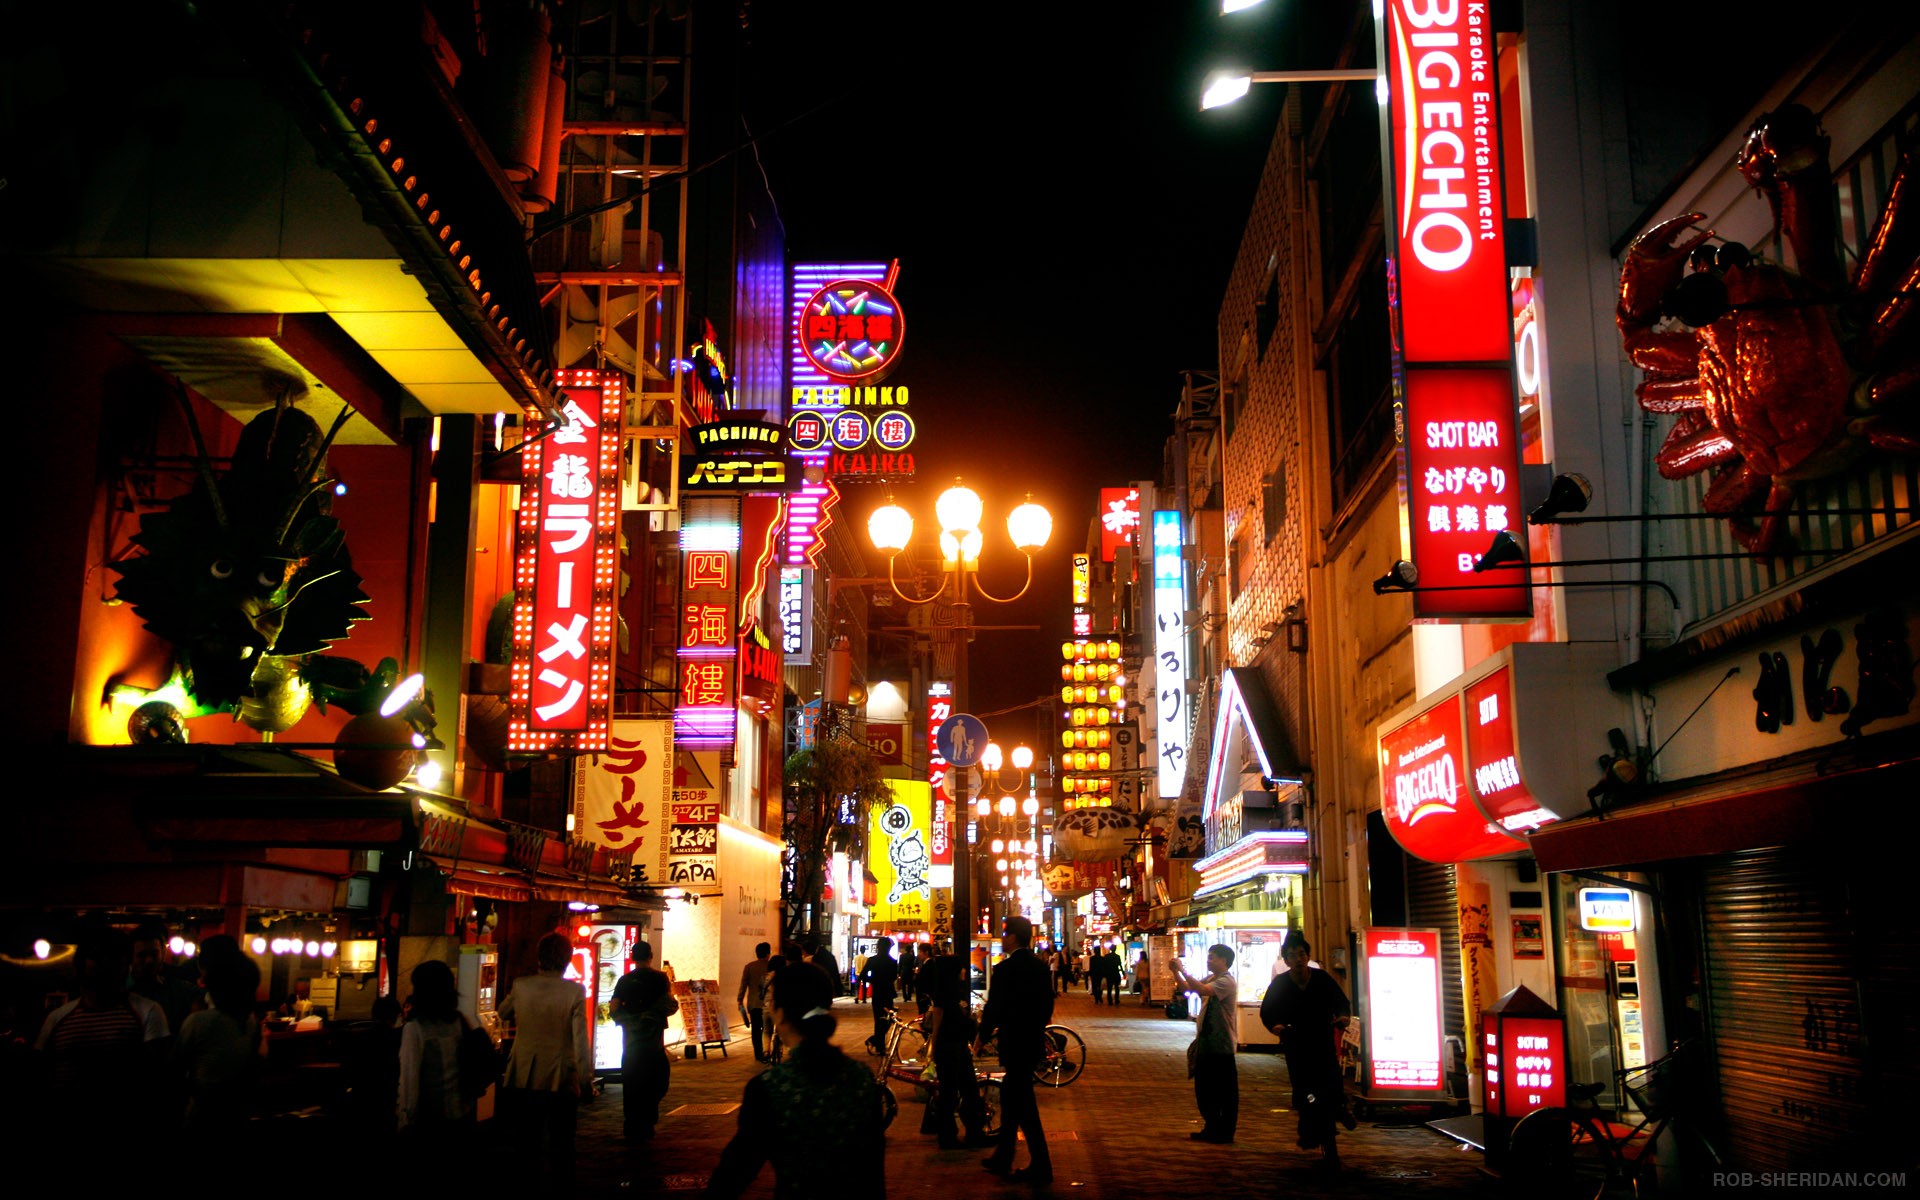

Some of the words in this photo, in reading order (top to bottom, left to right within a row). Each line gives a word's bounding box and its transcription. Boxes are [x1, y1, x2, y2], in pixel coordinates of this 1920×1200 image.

[1468, 3, 1487, 82] Karaoke
[1472, 92, 1496, 241] Entertainment
[792, 386, 909, 406] PACHINKO
[699, 426, 780, 444] PACHINKO
[1427, 421, 1465, 448] SHOT
[1467, 421, 1499, 447] BAR
[688, 461, 785, 485] パチンコ
[1424, 466, 1506, 495] なげやり
[535, 400, 598, 723] 金龍ラーメン
[1158, 611, 1185, 772] いろりや
[595, 736, 650, 857] ラーメン
[689, 805, 716, 822] 4F
[669, 861, 716, 883] TAPA
[1529, 1095, 1541, 1104] B1
